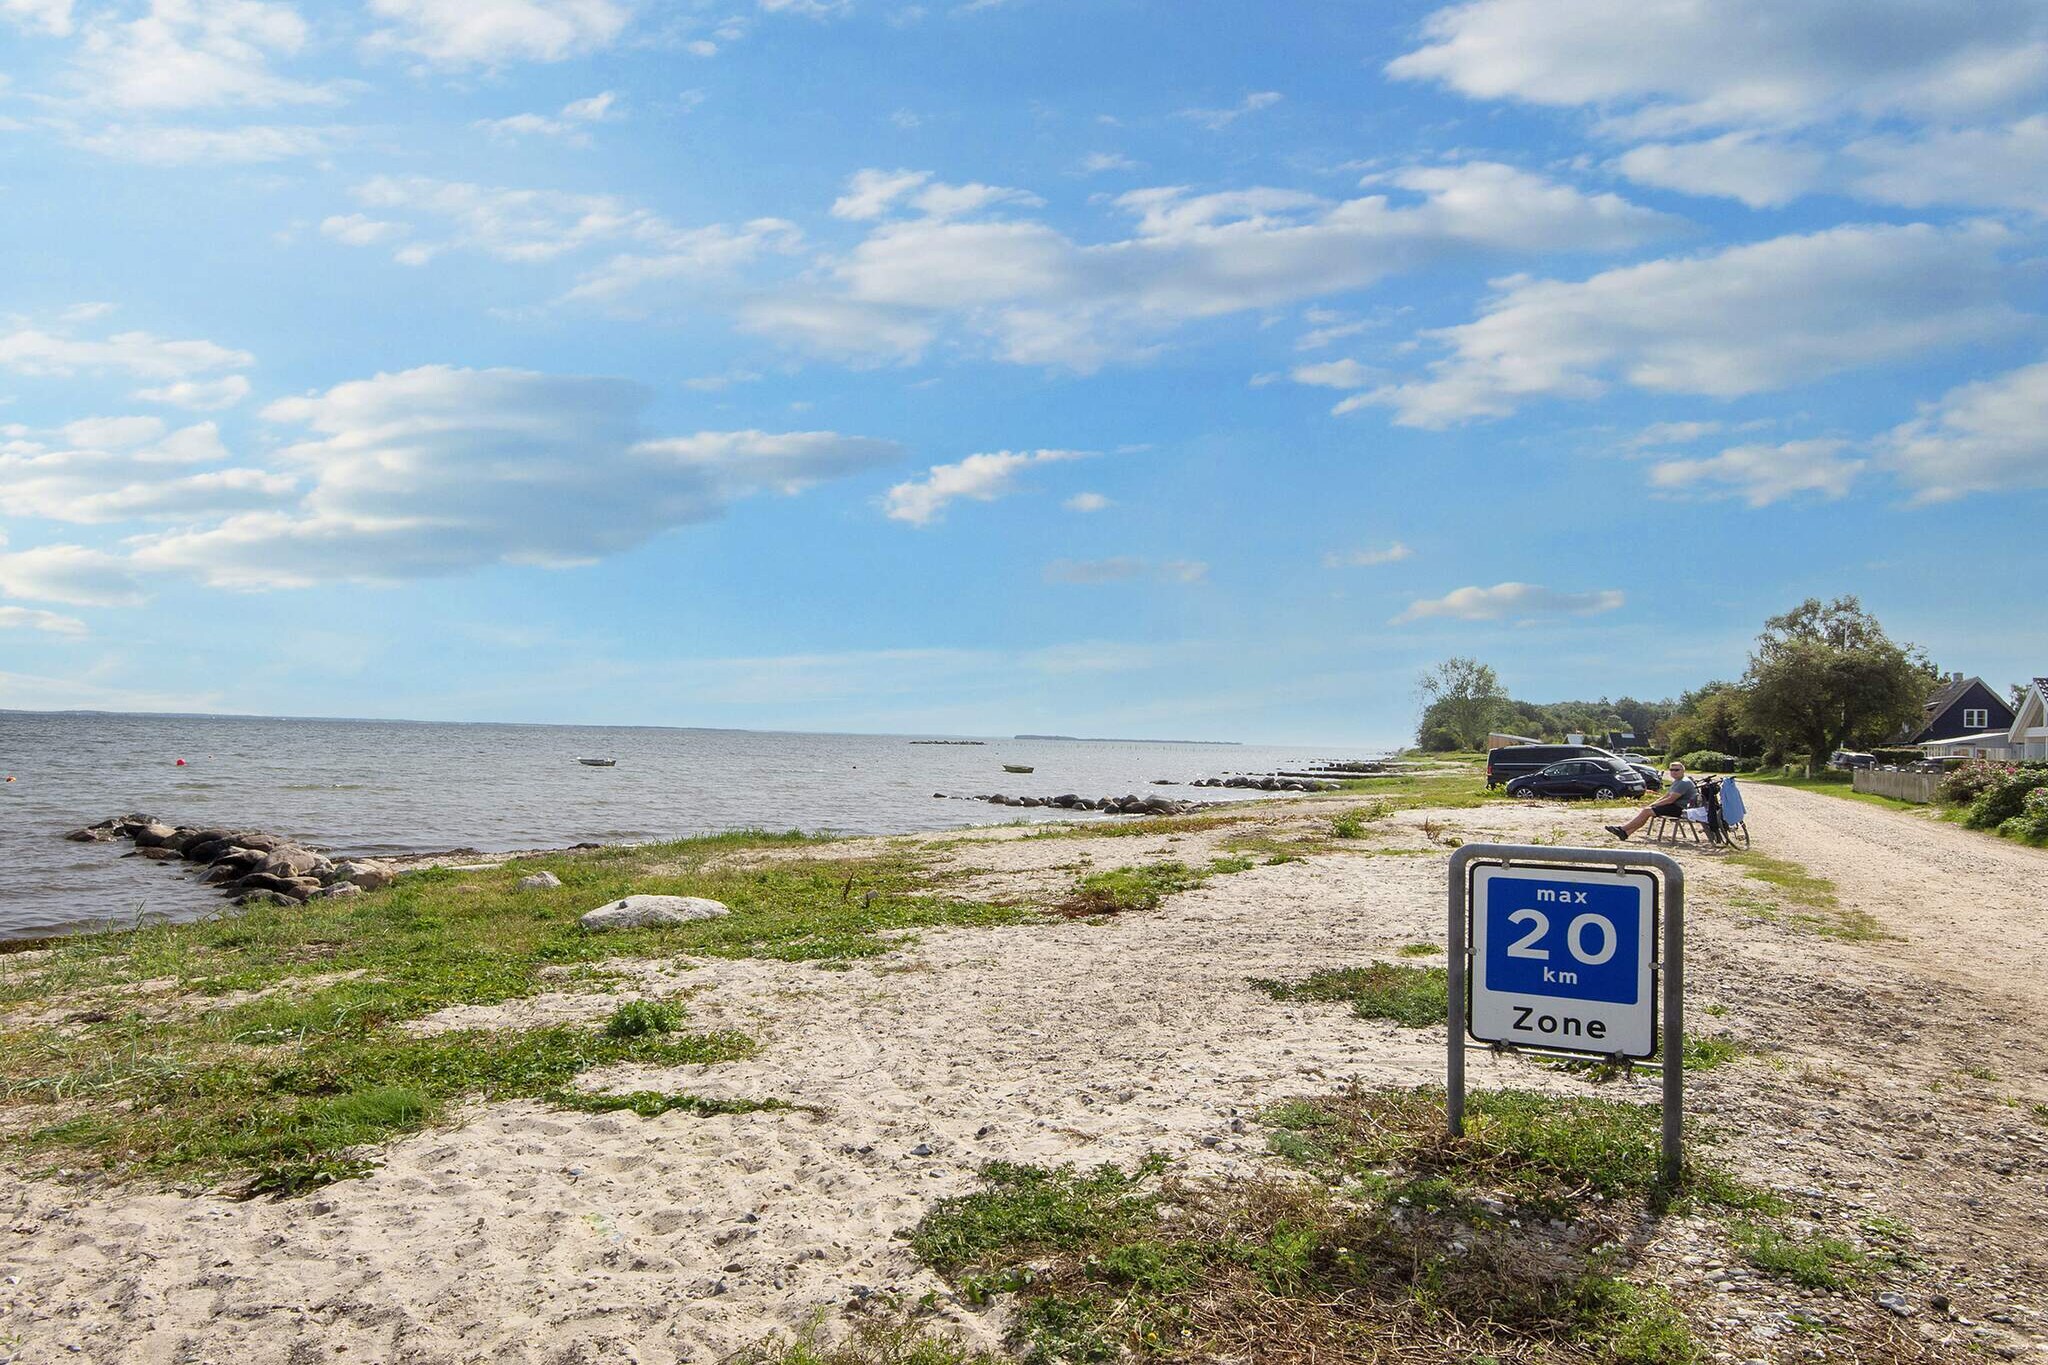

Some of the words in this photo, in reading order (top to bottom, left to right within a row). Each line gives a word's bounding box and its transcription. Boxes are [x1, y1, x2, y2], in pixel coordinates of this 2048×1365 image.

[1536, 888, 1587, 904] max
[1507, 908, 1617, 966] 20
[1543, 966, 1578, 985] km
[1512, 1005, 1607, 1039] Zone
